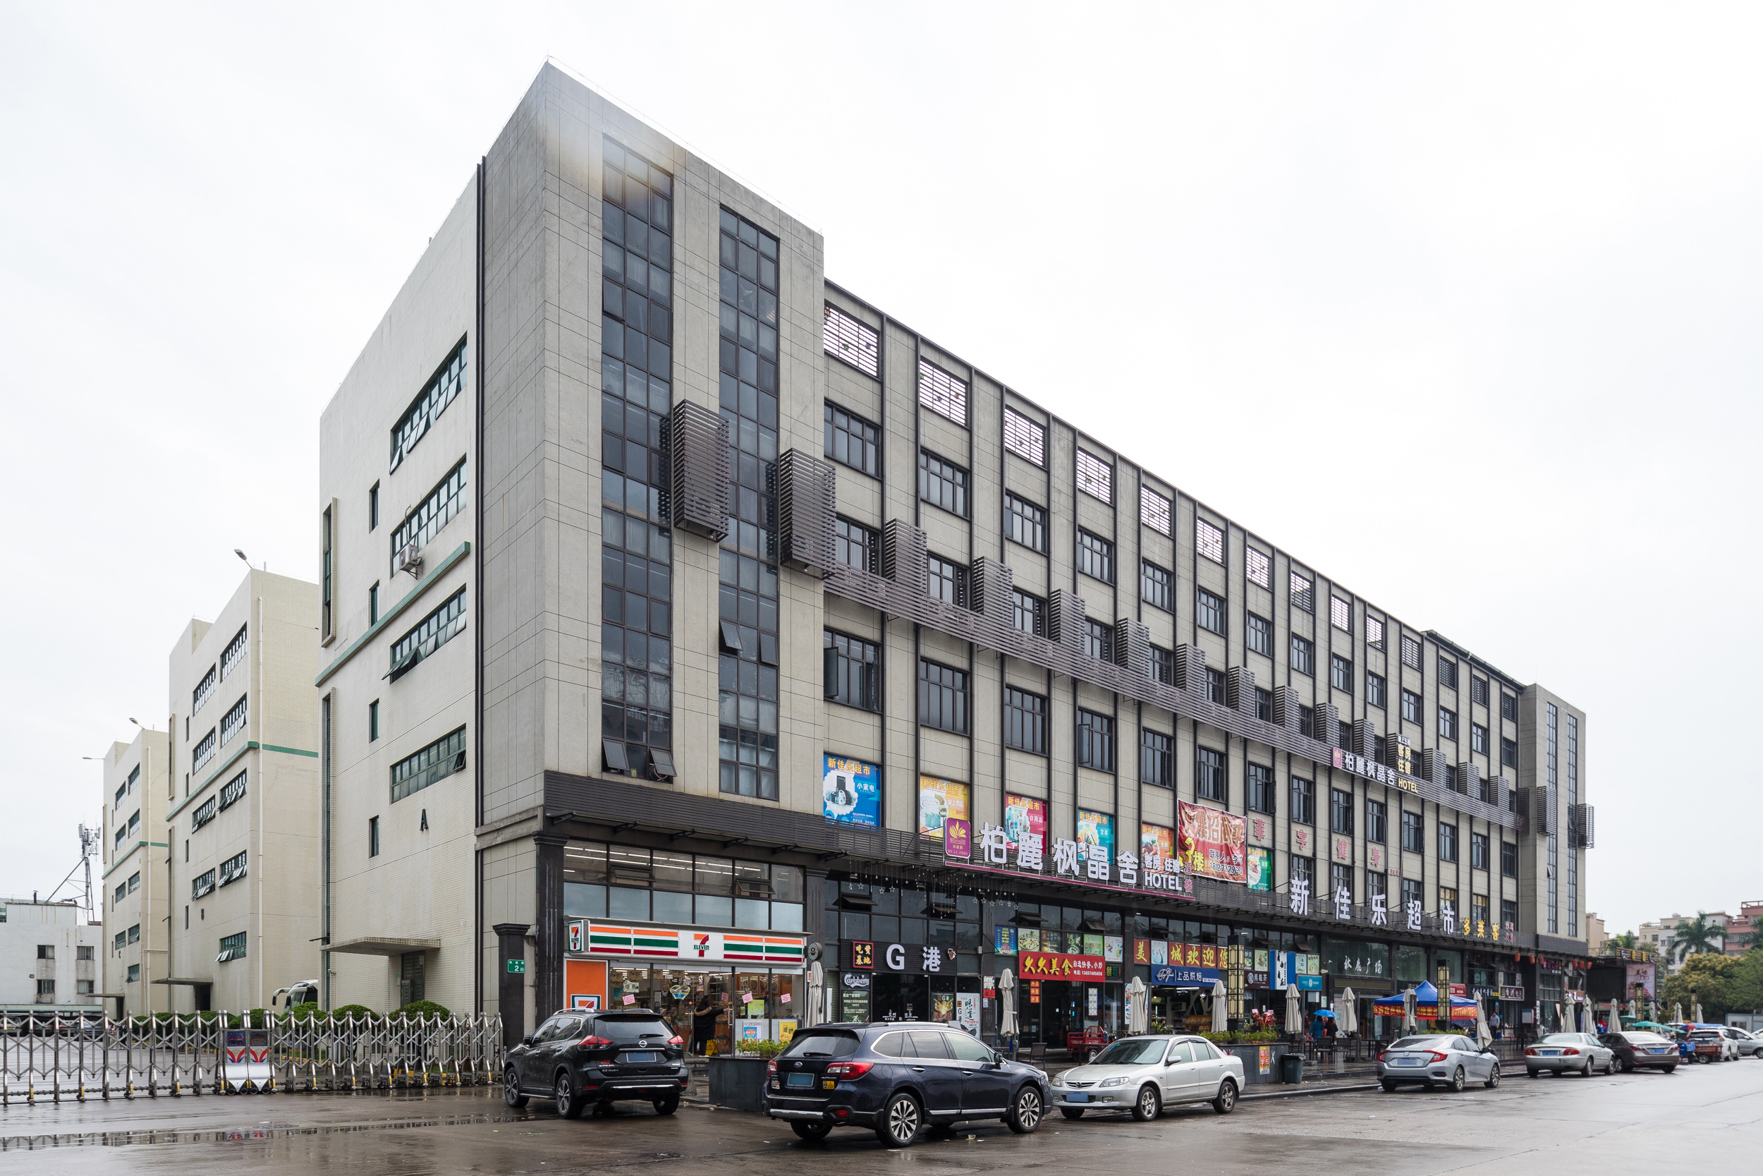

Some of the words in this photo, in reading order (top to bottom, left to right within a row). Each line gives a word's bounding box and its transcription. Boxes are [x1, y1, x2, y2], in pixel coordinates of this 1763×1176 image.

[828, 757, 870, 775] 新佳乐超市
[857, 782, 875, 792] 小家电
[1398, 778, 1418, 793] HOTEL
[420, 808, 429, 832] A
[980, 821, 1139, 884] 柏麗枫晶舍
[1145, 854, 1160, 870] 客房
[1145, 871, 1182, 891] HOTEL
[1290, 876, 1454, 935] 新佳乐超市
[694, 934, 709, 957] 7
[1024, 955, 1073, 976] 久久美食
[1177, 971, 1202, 982] 上品烘焙
